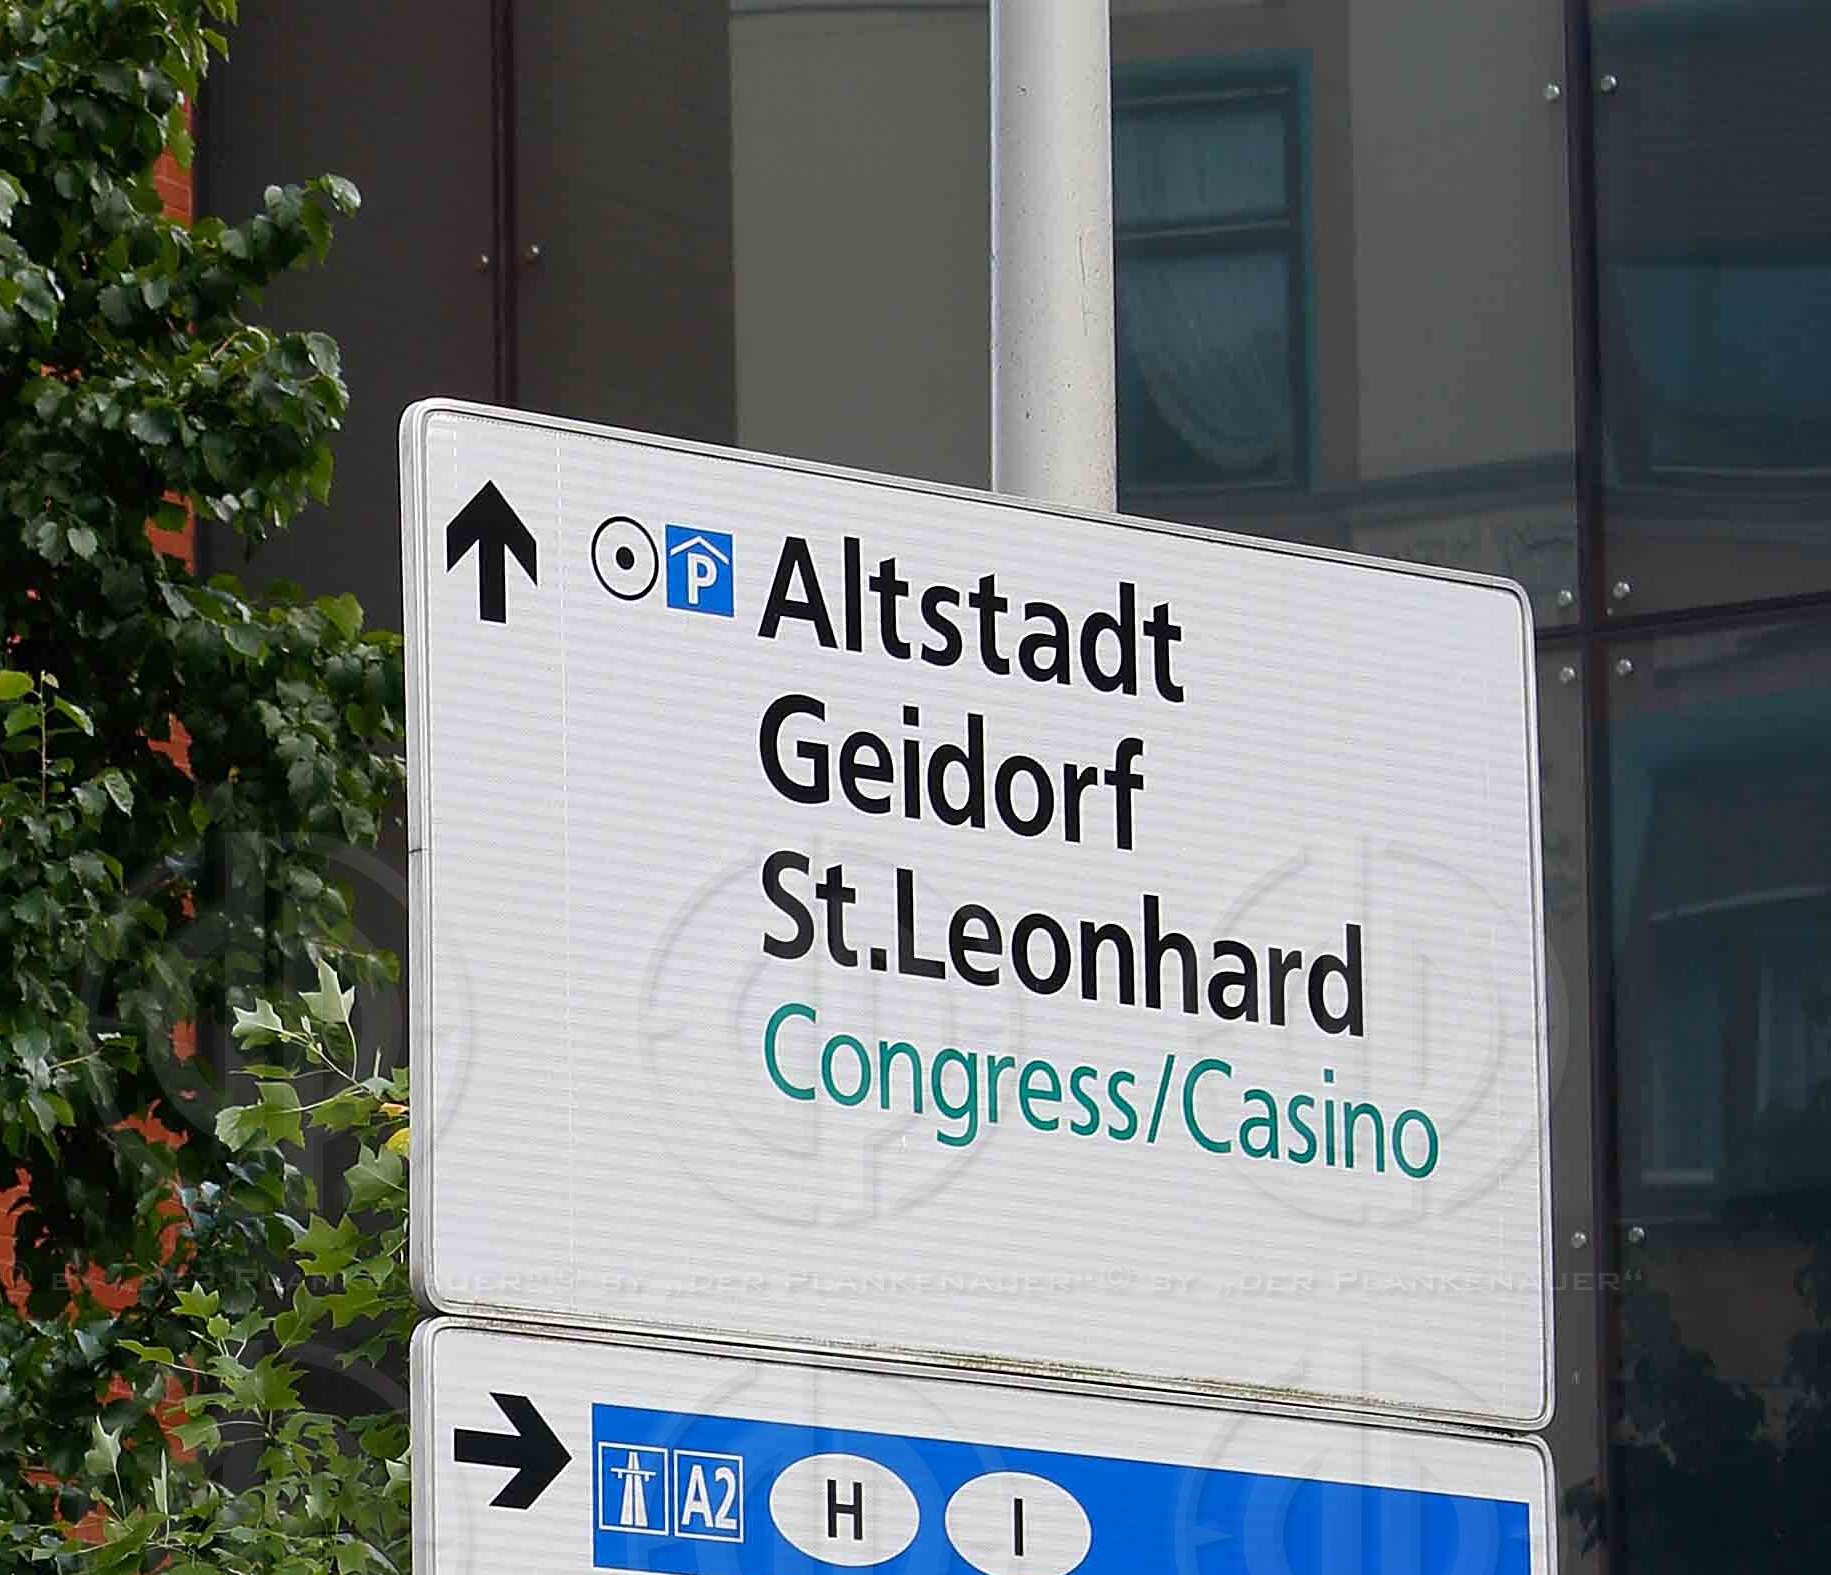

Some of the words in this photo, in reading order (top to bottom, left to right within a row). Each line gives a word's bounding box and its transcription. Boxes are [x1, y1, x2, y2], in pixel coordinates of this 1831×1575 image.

[757, 536, 1184, 703] Altstadt
[759, 694, 1144, 851] Geidorf
[762, 850, 1364, 1037] St.Leonhard
[764, 1001, 1440, 1178] Congress/Casino
[681, 1465, 738, 1530] A2
[827, 1479, 863, 1541] H
